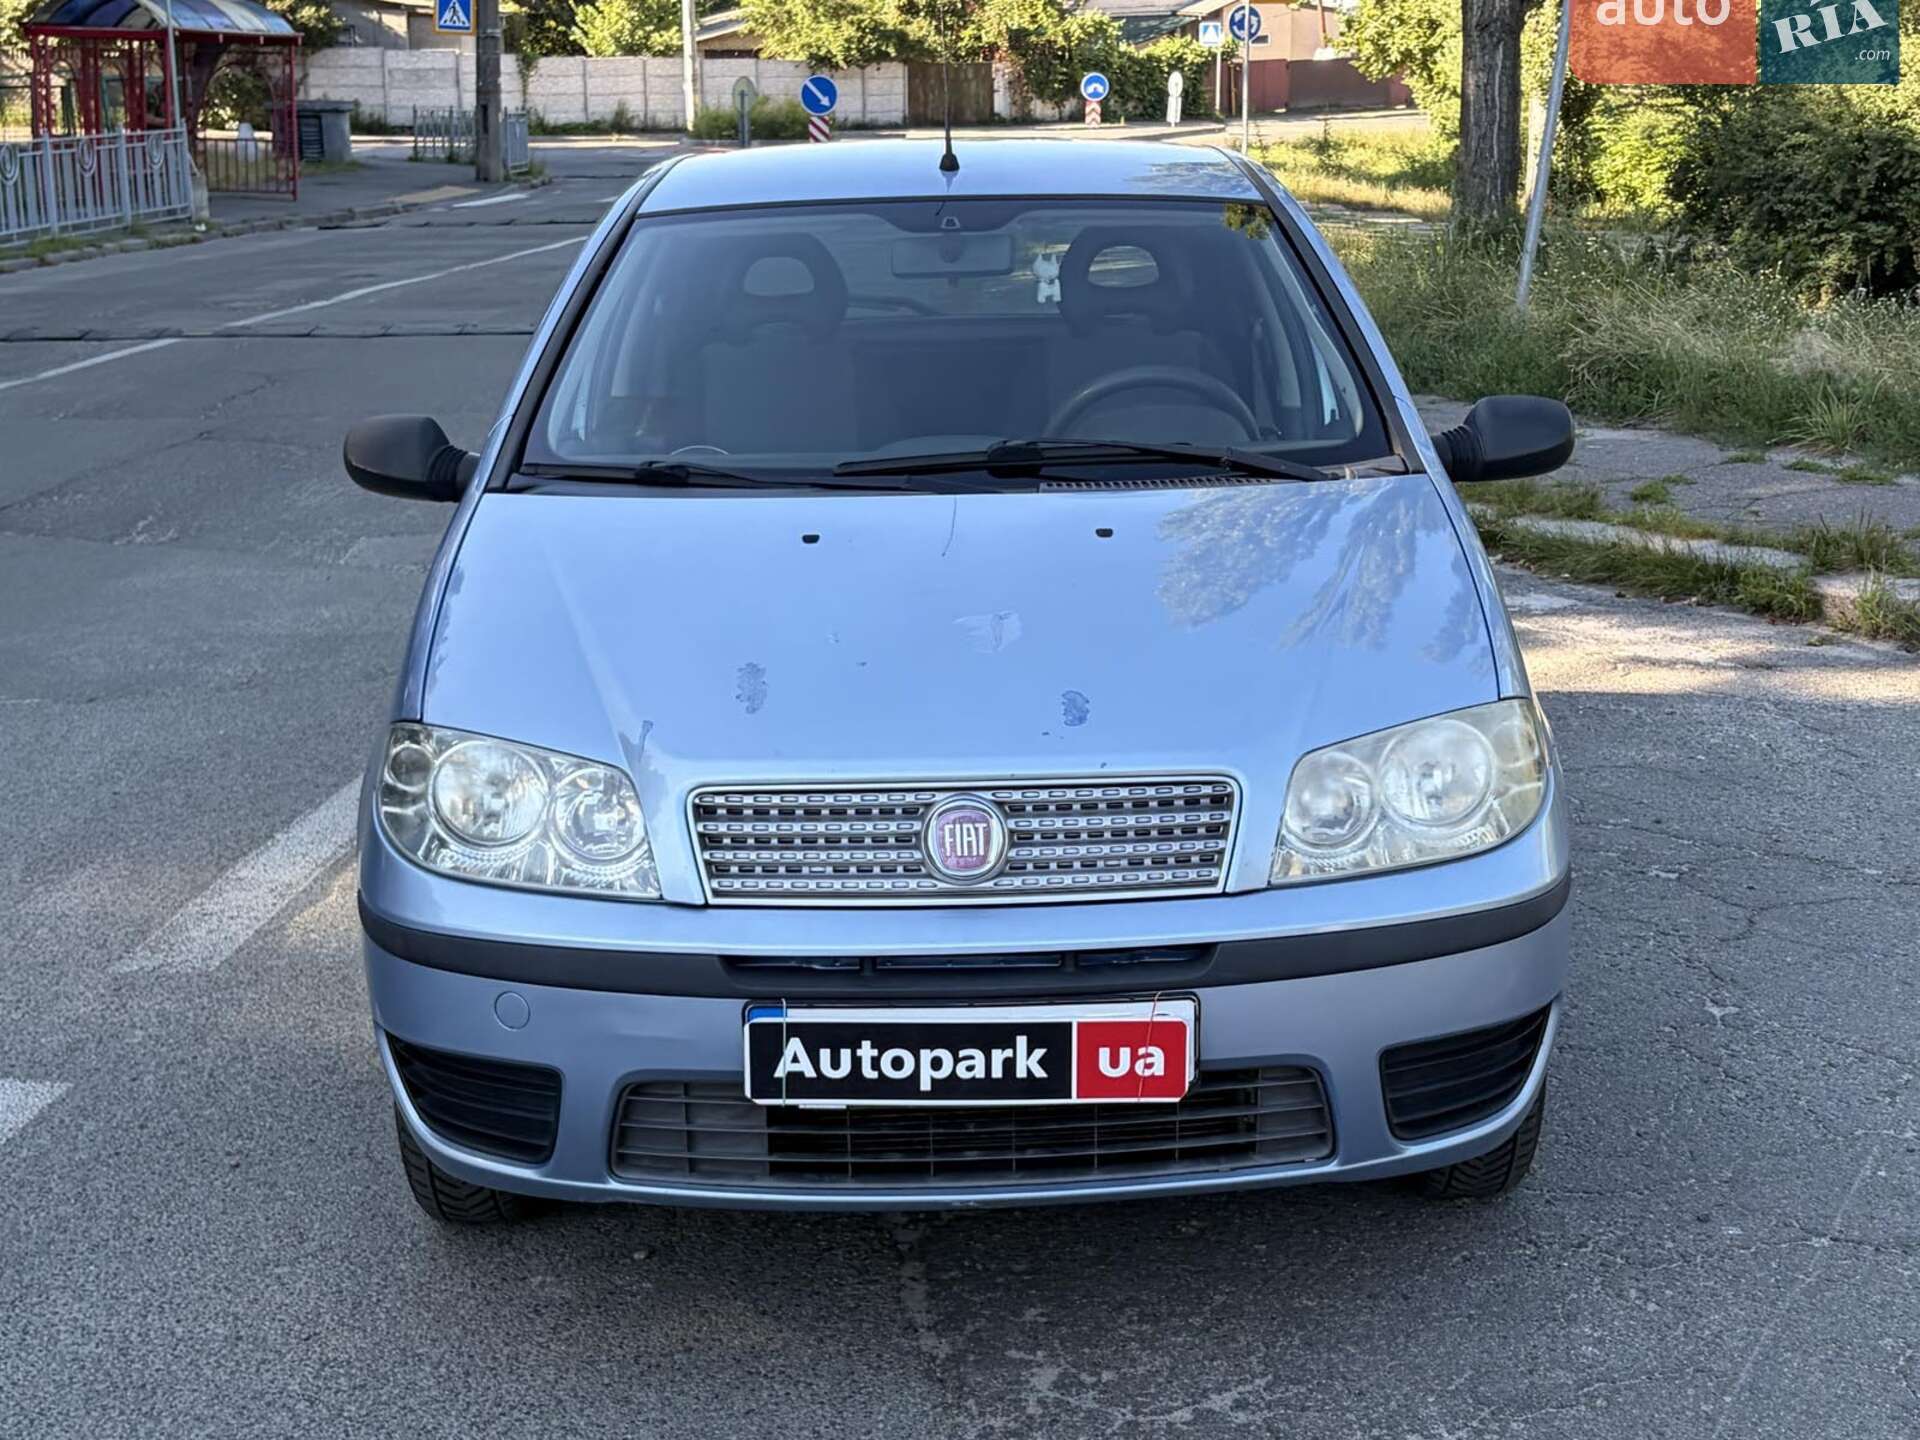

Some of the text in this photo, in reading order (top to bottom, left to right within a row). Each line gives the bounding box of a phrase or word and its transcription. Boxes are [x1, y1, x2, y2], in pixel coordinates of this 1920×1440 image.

[943, 823, 988, 856] FIAT
[774, 1035, 1166, 1091] Autopark ua
